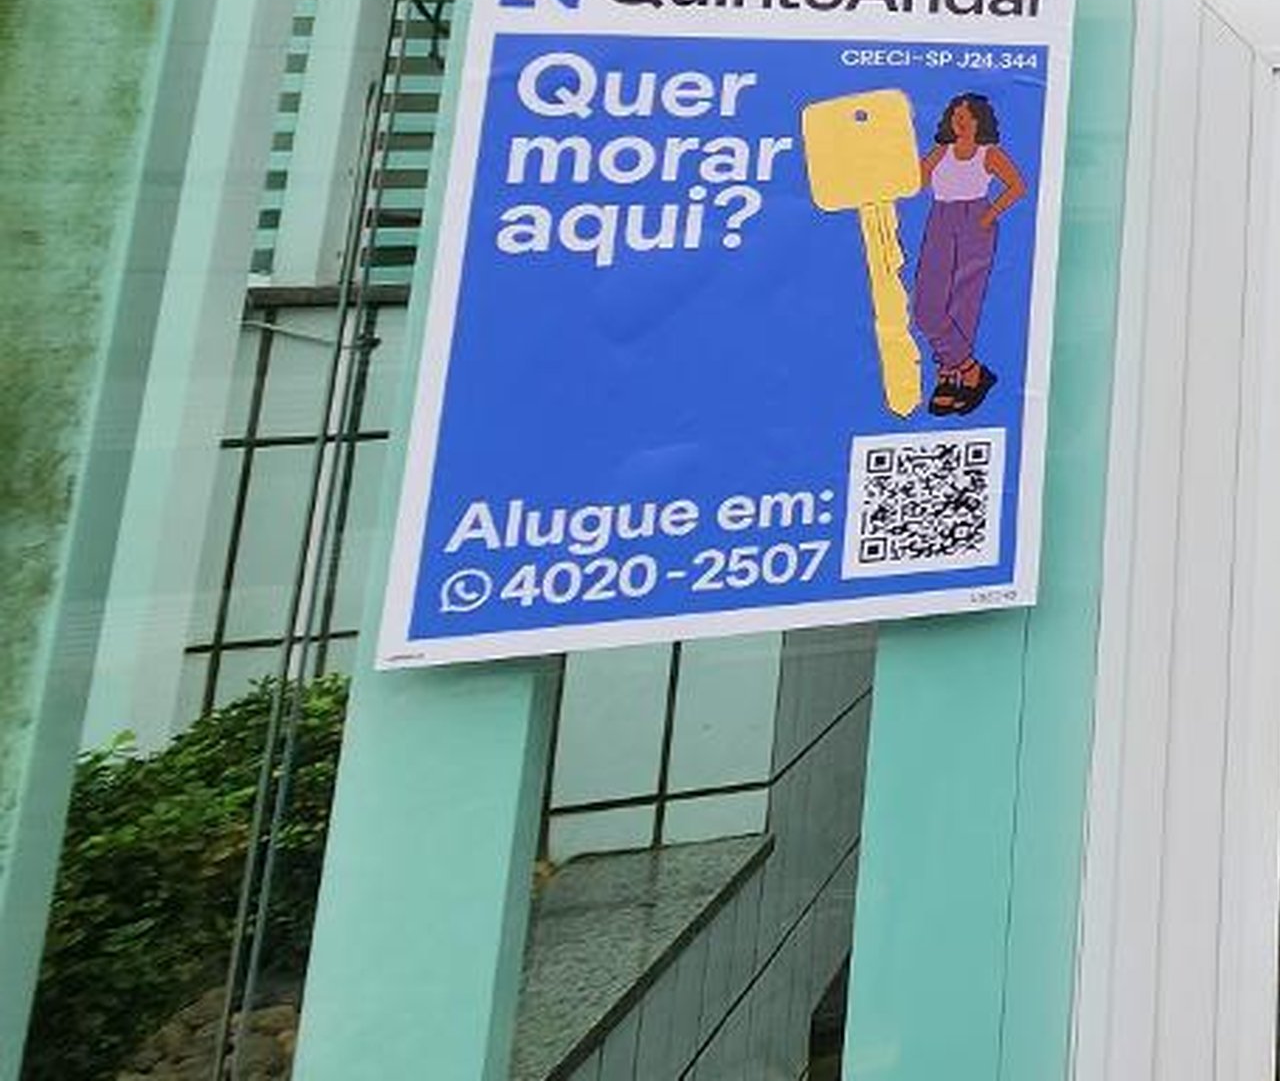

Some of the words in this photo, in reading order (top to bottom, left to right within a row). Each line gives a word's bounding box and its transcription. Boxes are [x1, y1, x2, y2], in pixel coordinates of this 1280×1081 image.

[517, 51, 757, 119] Quer
[841, 49, 952, 67] CRECI-SP
[956, 52, 1038, 69] J24.344
[505, 131, 792, 184] morar
[496, 185, 761, 267] aqui?
[444, 497, 699, 556] Alugue
[716, 486, 834, 531] em:
